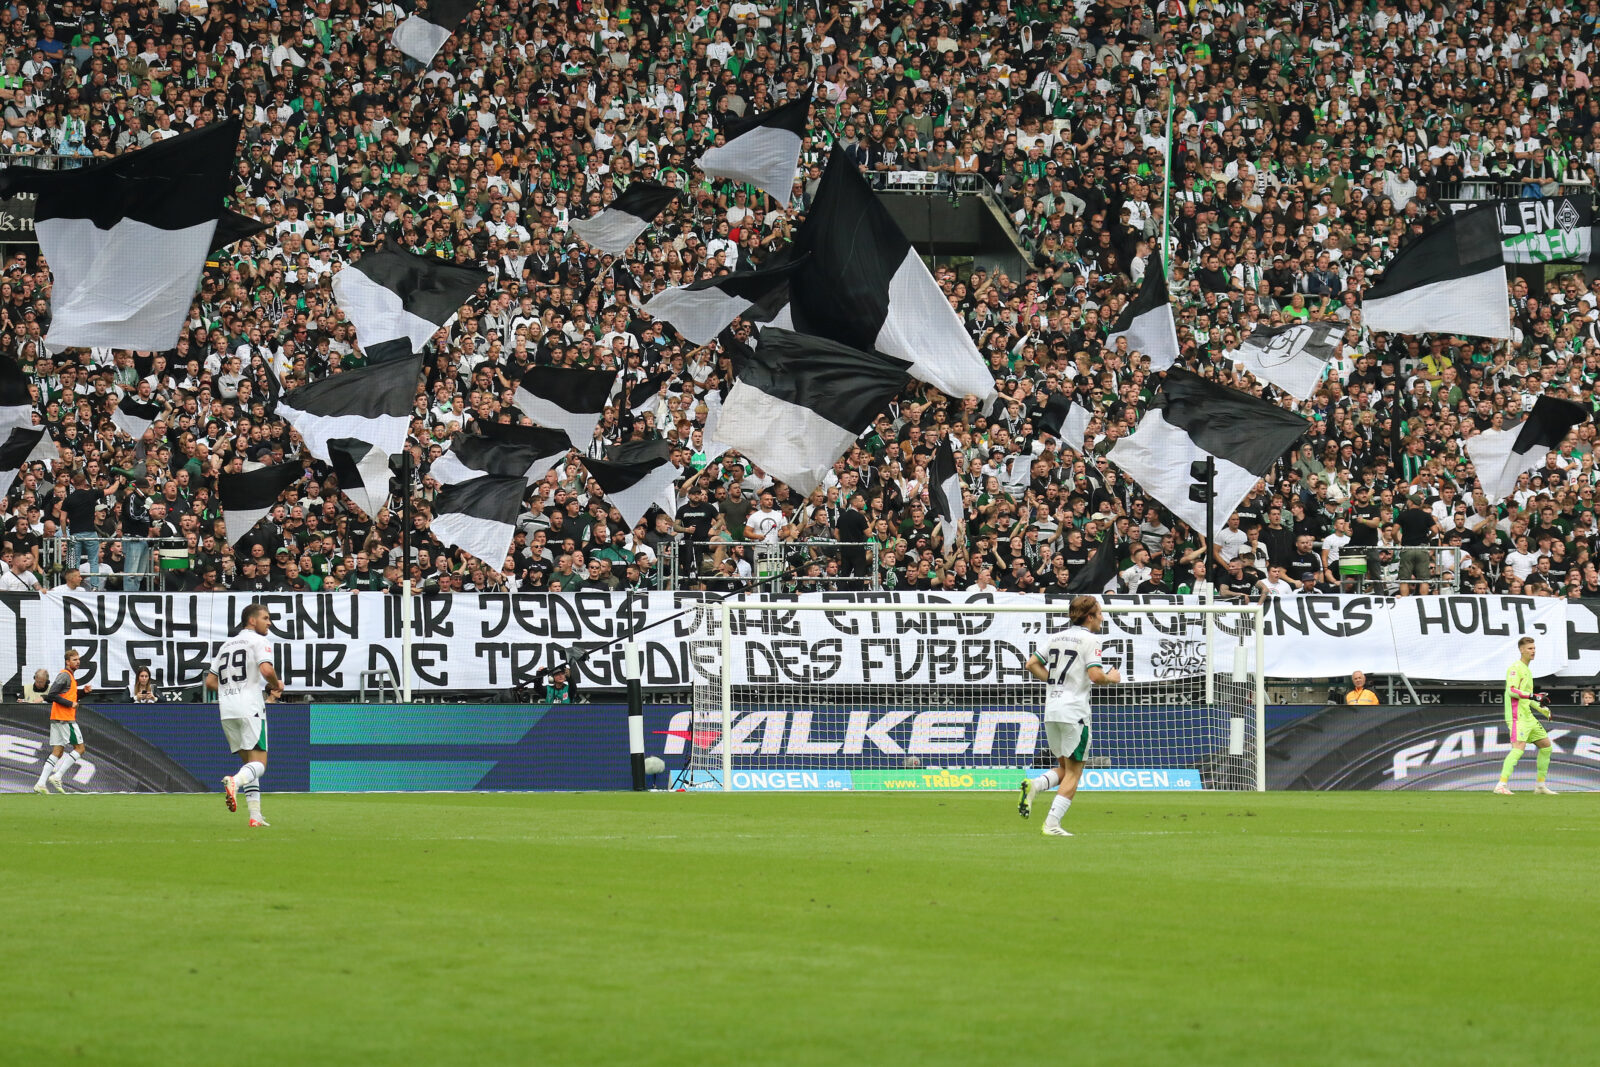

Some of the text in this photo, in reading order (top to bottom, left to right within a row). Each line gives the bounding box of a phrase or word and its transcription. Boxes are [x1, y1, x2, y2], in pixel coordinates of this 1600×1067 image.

[1503, 228, 1581, 262] TREU
[62, 594, 198, 638] AUCH
[384, 594, 454, 638] IHR
[479, 592, 650, 640] JEDES
[674, 591, 801, 637] JAHR
[823, 591, 995, 636] ETWAS
[1416, 596, 1548, 636] HOLT,
[64, 638, 227, 687] BLEIB
[274, 643, 348, 688] IHR
[368, 643, 448, 688] DE
[745, 638, 843, 684] DES
[219, 649, 247, 685] 29
[1047, 648, 1078, 685] 27
[664, 711, 1040, 755] FALKEN
[732, 772, 819, 788] ONGEN
[884, 780, 920, 788] www.
[978, 778, 997, 788] .de
[1173, 778, 1191, 787] .de
